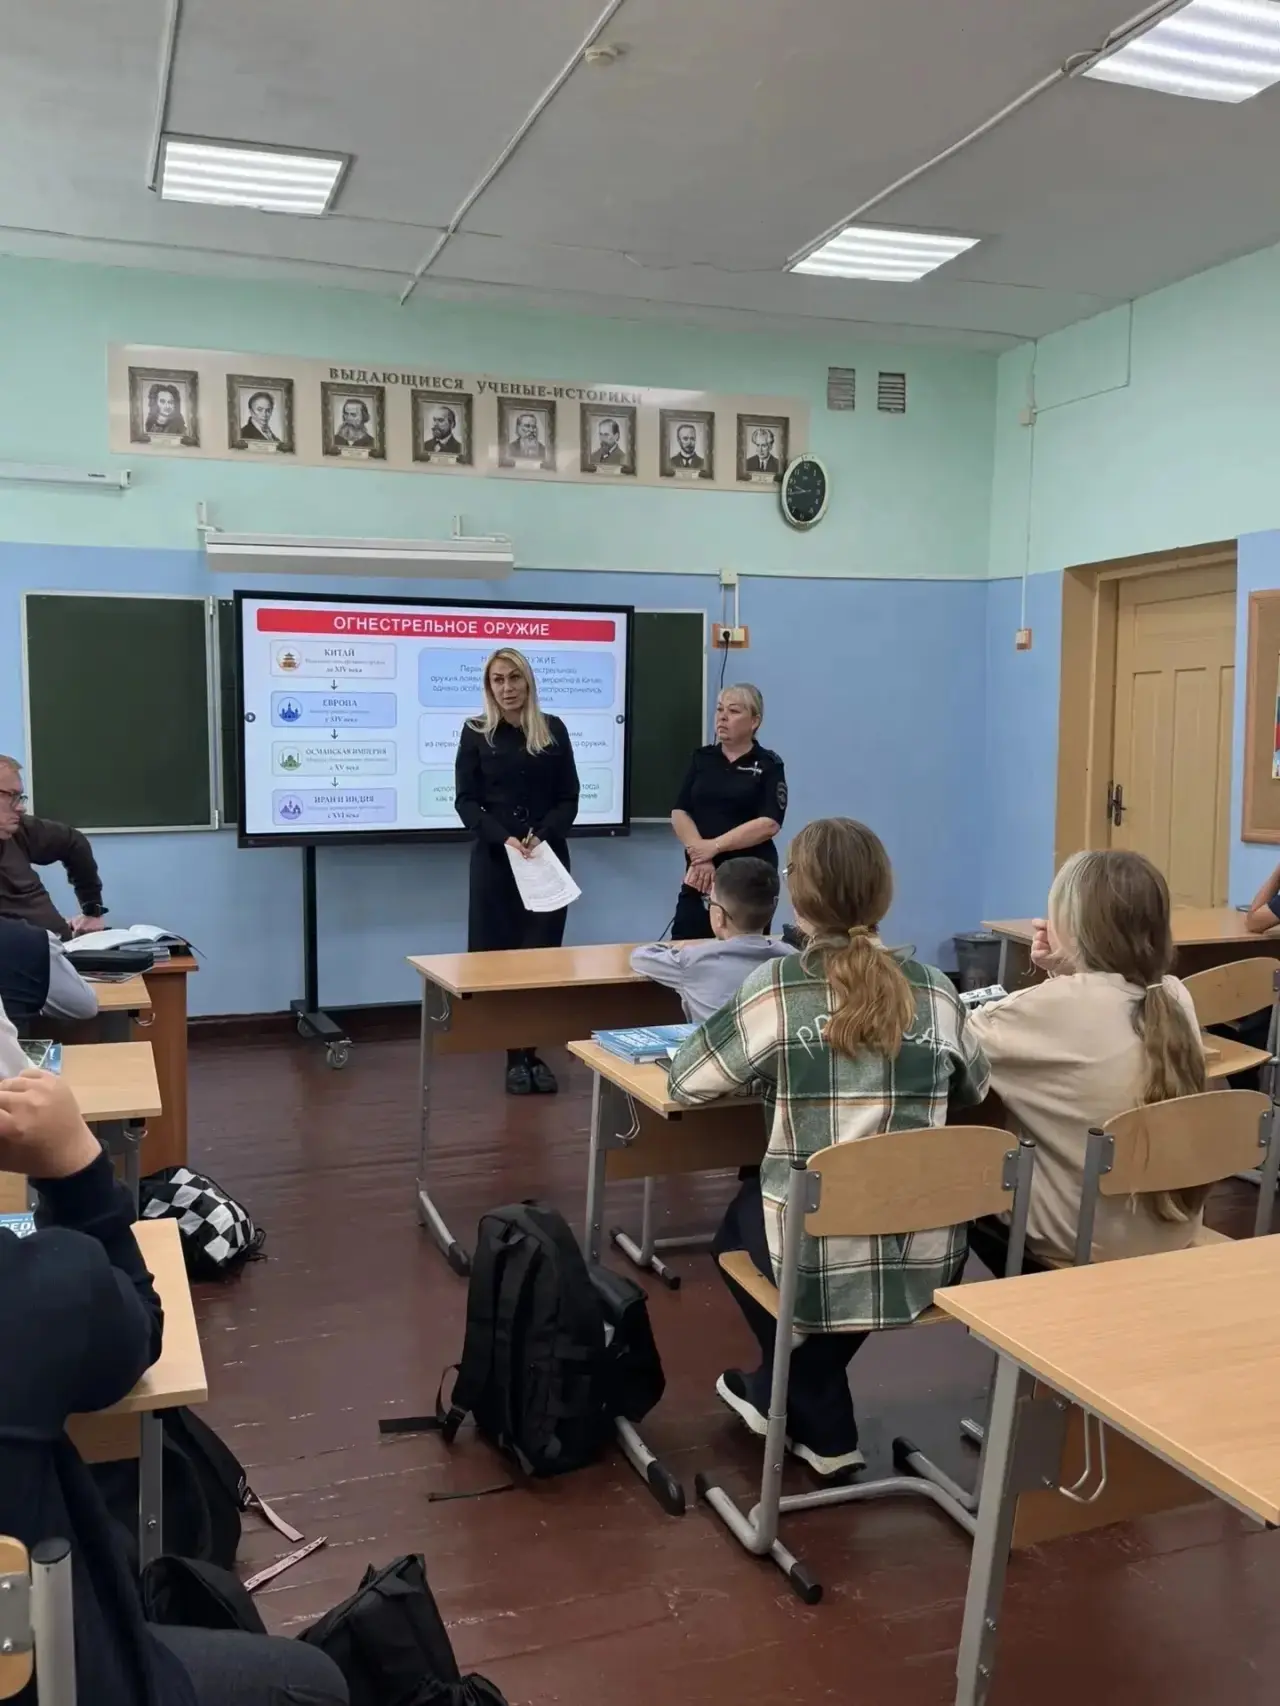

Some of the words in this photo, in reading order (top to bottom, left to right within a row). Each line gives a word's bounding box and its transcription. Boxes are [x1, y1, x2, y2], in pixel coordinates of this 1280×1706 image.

[329, 367, 464, 390] ВЫДАЮЩИЕСЯ
[476, 380, 643, 405] УЧЕНЫЕ-ИСТОРИКИ
[333, 615, 478, 634] ОГНЕСТРЕЛЬНОЕ
[483, 620, 550, 636] ОРУЖИЕ
[324, 648, 355, 657] КИТАЙ
[322, 699, 358, 707] ЕВРОПА
[305, 747, 351, 756] ОСМАНСКАЯ
[351, 748, 387, 756] ИМПЕРИЯ
[314, 796, 336, 804] ИРАН
[337, 796, 344, 804] И
[345, 795, 375, 804] ИНДИЯ
